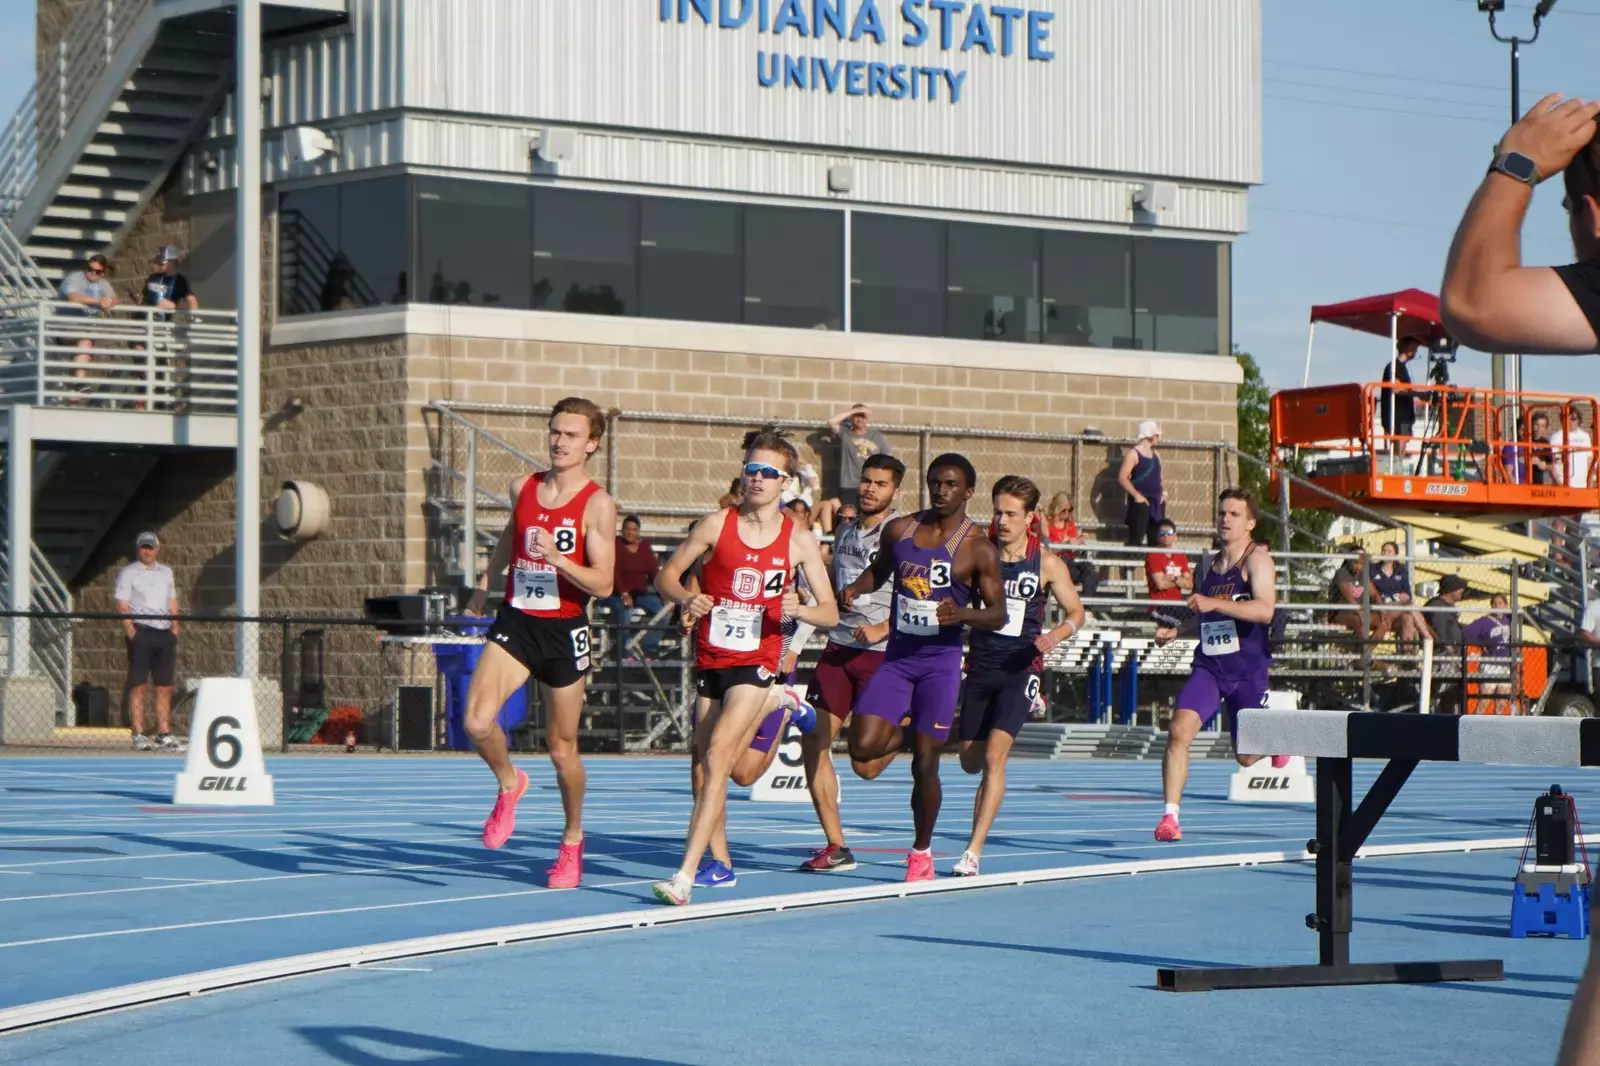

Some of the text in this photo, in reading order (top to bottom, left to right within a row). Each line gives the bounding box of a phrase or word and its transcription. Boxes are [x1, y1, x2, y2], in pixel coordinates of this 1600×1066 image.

[900, 0, 1055, 61] STATE
[757, 50, 968, 104] UNIVERSITY
[556, 530, 574, 552] 8
[739, 573, 755, 594] B
[765, 572, 784, 594] 4
[932, 565, 949, 586] 3
[525, 586, 545, 599] 76
[1018, 577, 1036, 598] 6
[720, 598, 767, 614] BRADLEY
[902, 612, 929, 627] 411
[575, 629, 588, 653] 8
[725, 625, 746, 639] 75
[1207, 634, 1231, 646] 418
[1028, 679, 1038, 700] 6
[206, 715, 243, 770] 6
[778, 720, 805, 768] 5
[198, 776, 248, 791] GILL
[771, 775, 809, 790] GIL
[1247, 776, 1290, 790] GILL
